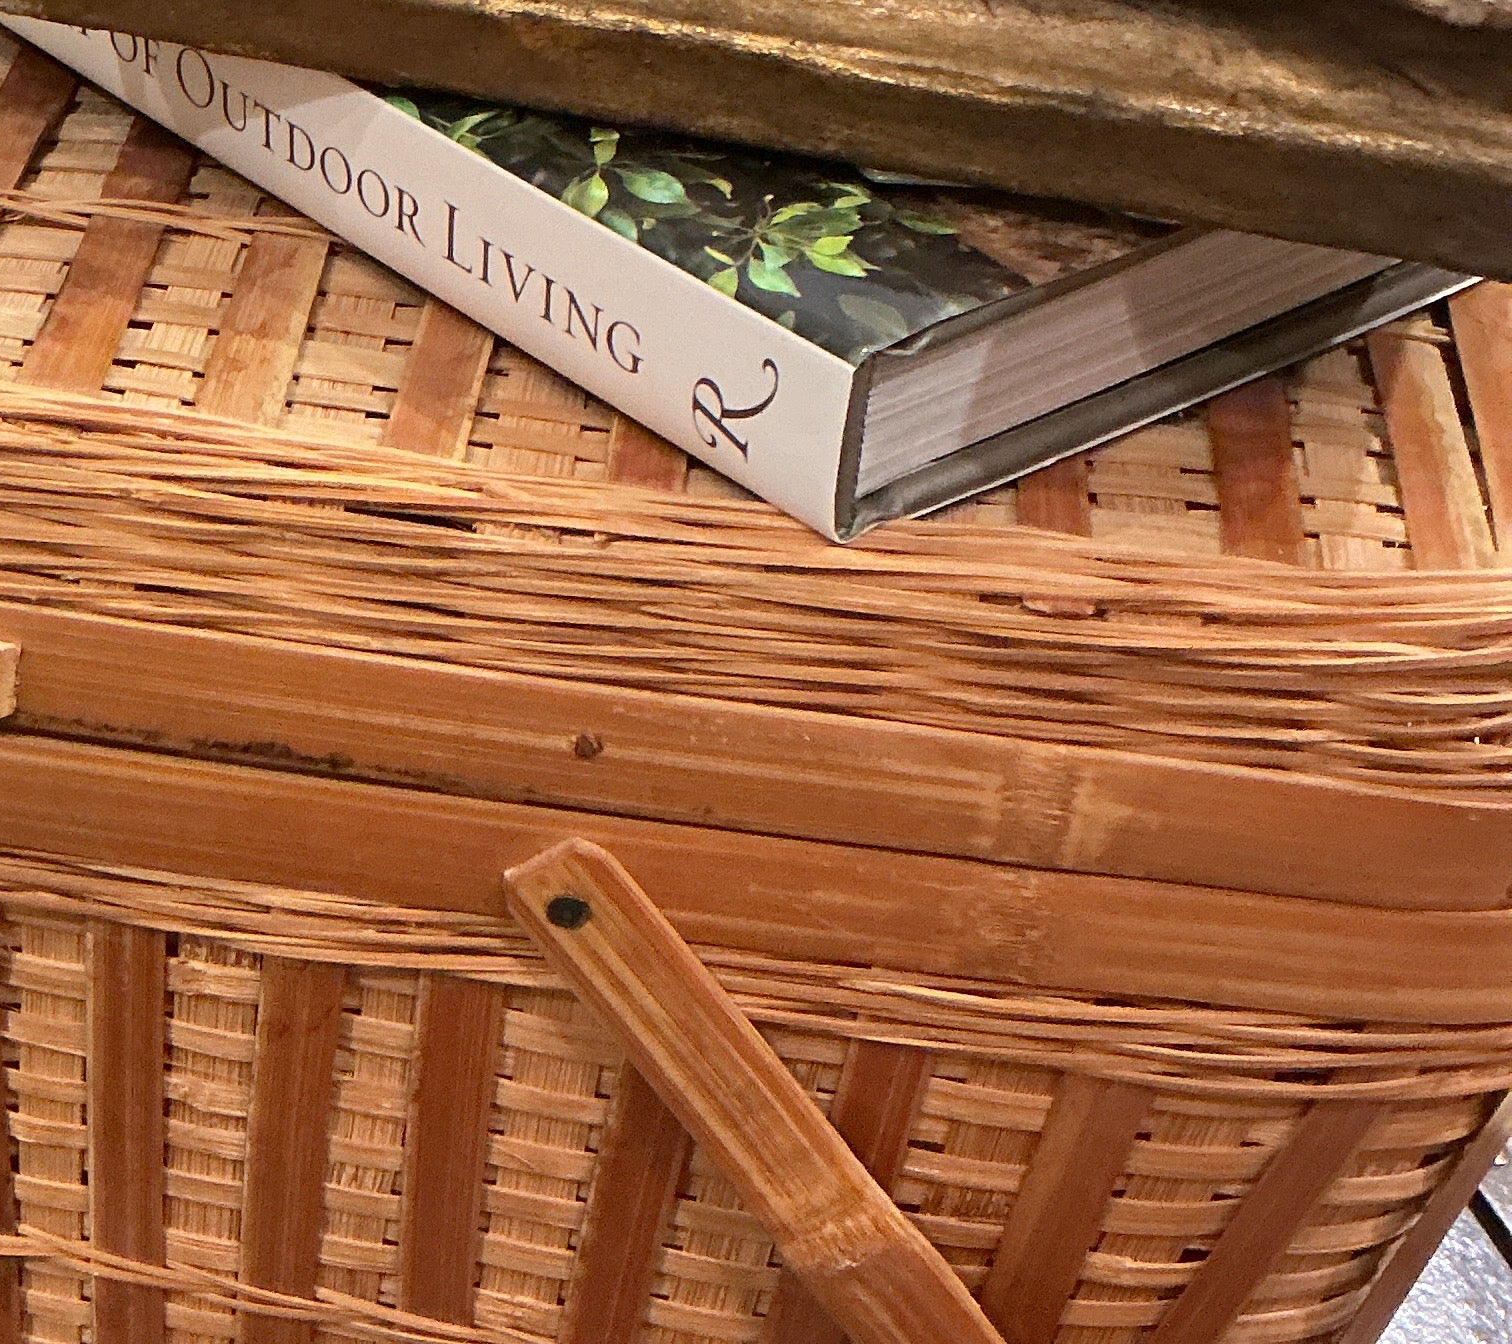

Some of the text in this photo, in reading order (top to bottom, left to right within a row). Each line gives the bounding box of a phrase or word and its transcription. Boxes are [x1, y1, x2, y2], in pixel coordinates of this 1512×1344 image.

[175, 47, 425, 248] OUTDOOR
[443, 201, 643, 374] LIVING
[691, 358, 779, 462] R
